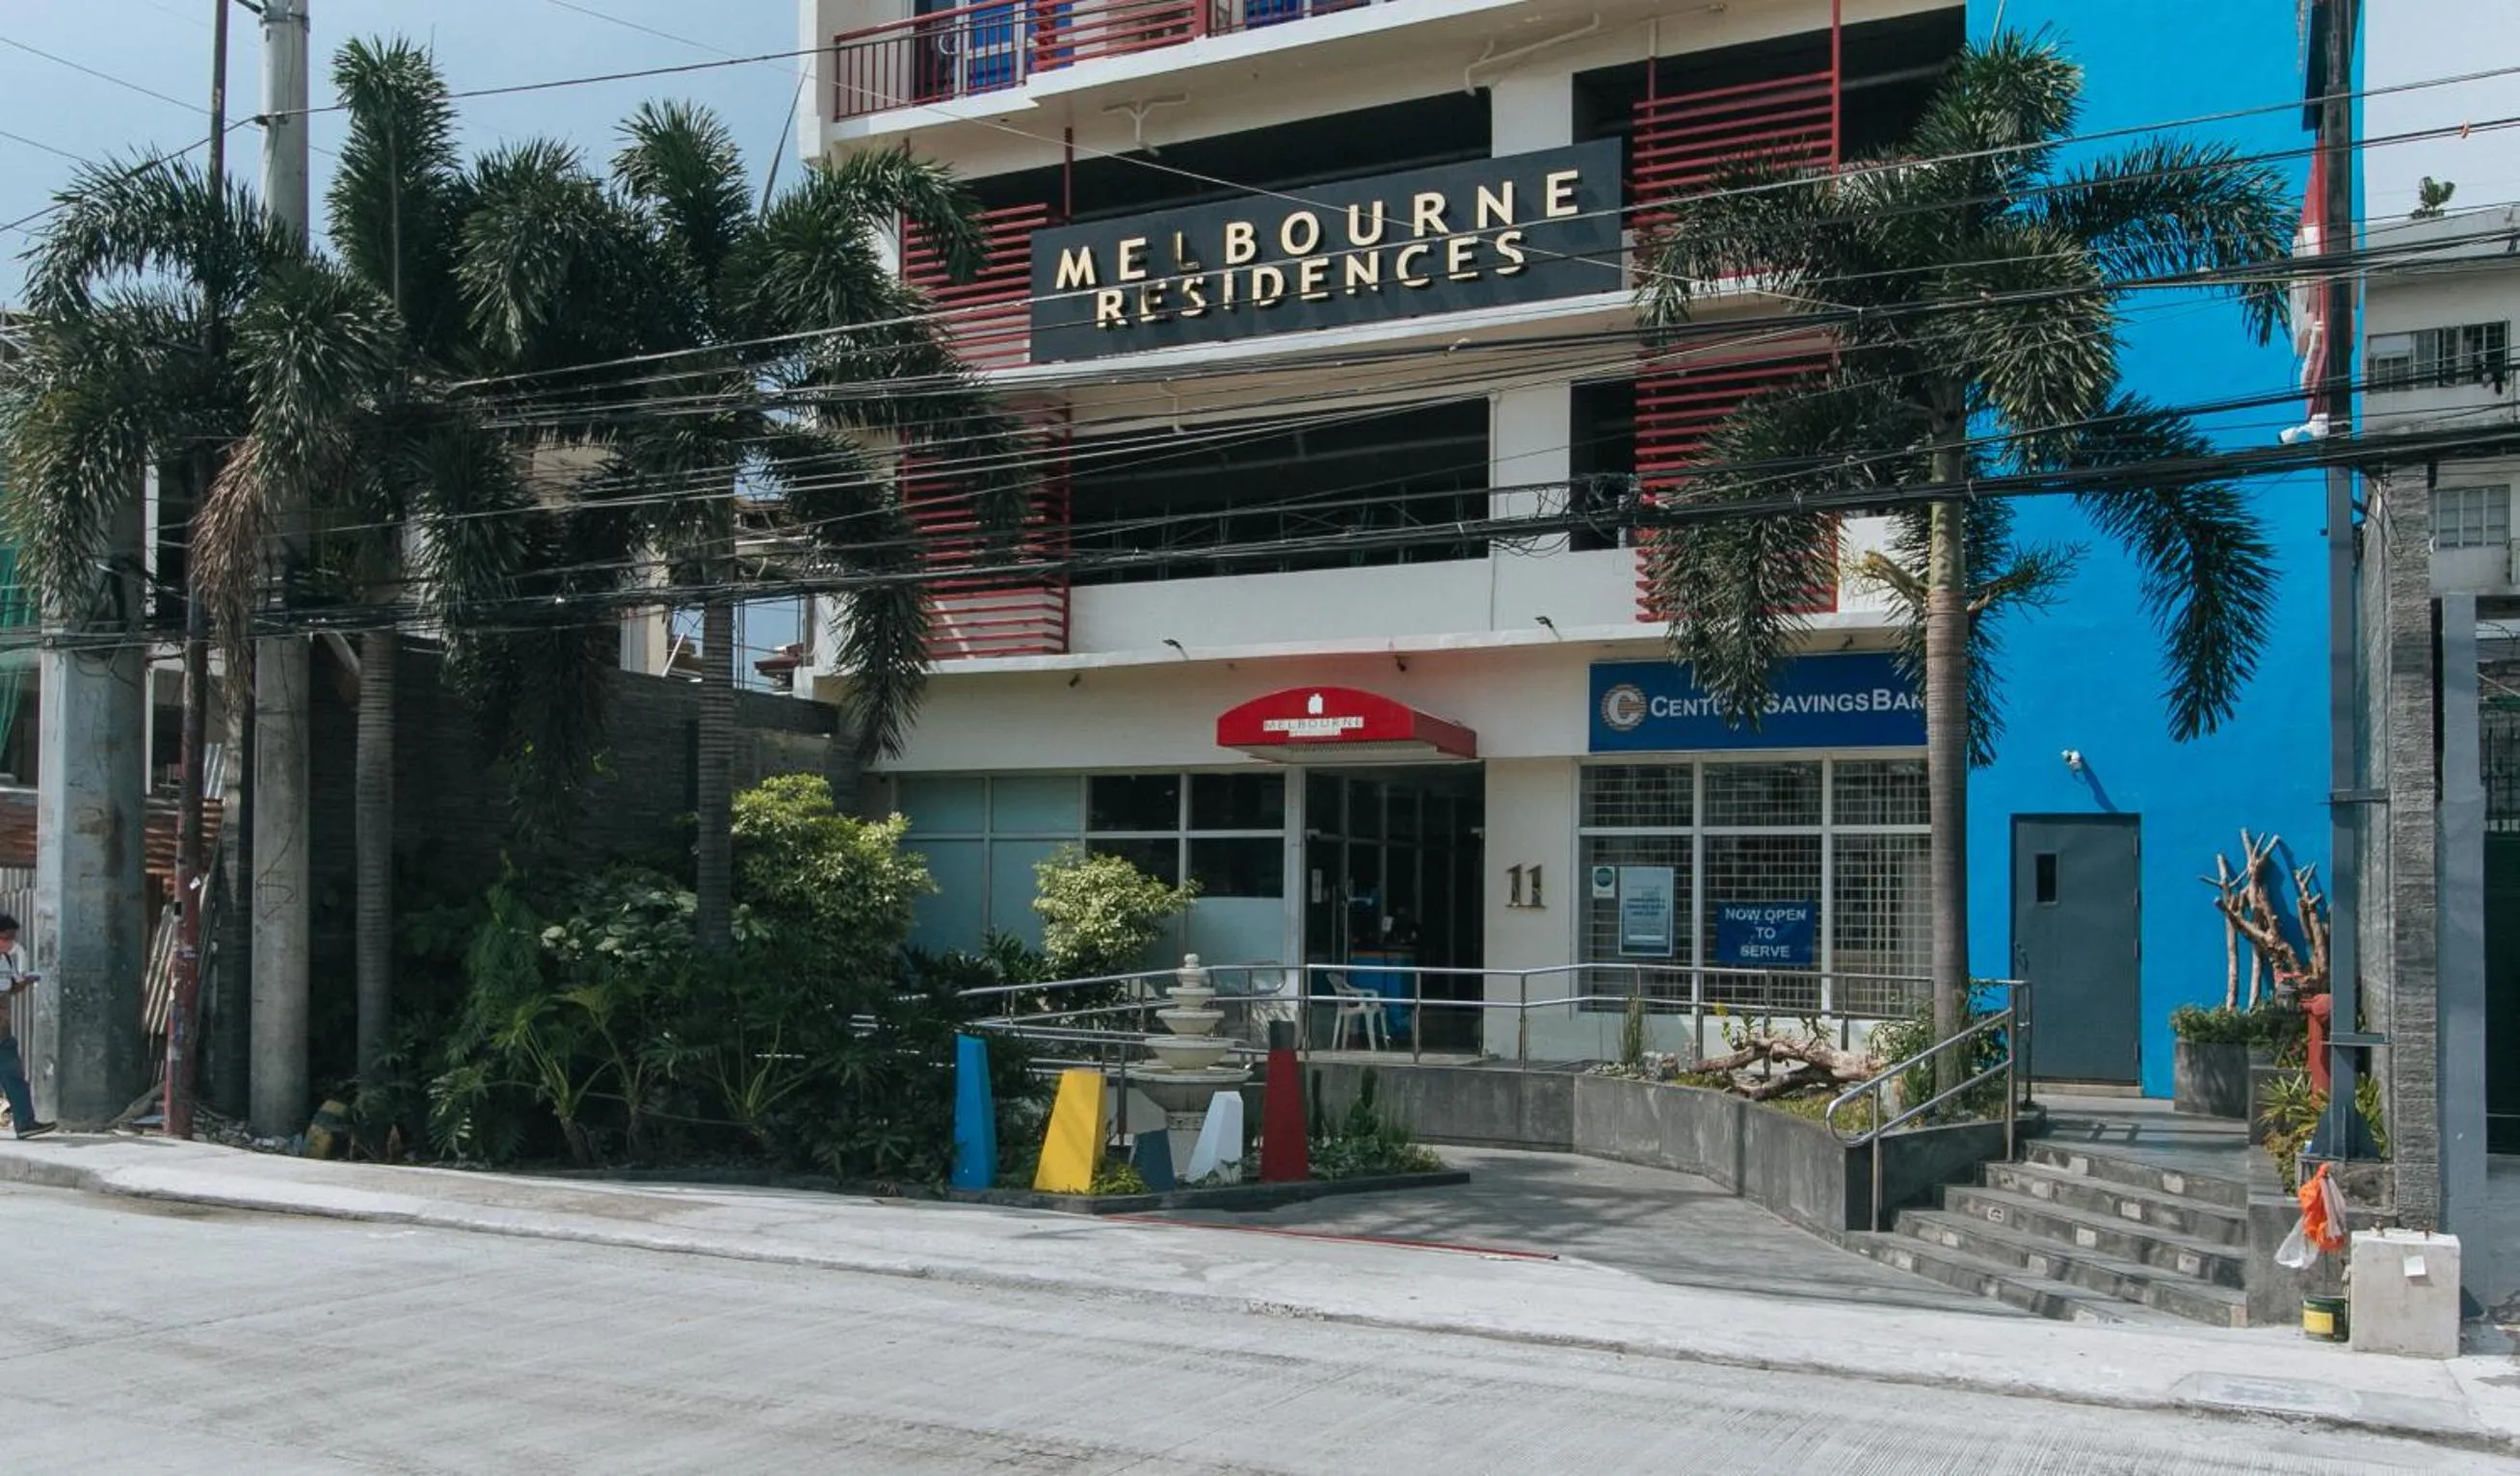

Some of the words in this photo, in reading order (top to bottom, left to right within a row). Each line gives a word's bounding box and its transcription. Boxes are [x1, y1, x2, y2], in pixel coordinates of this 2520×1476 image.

[1056, 170, 1578, 289] MELBOURNE
[1097, 231, 1525, 329] RESIDENCES
[1264, 717, 1362, 730] MELBOURNE
[1506, 863, 1547, 909] 11
[1725, 908, 1761, 921] NOW
[1764, 908, 1807, 922] OPEN
[1755, 926, 1776, 939] TO
[1739, 944, 1791, 959] SERVE
